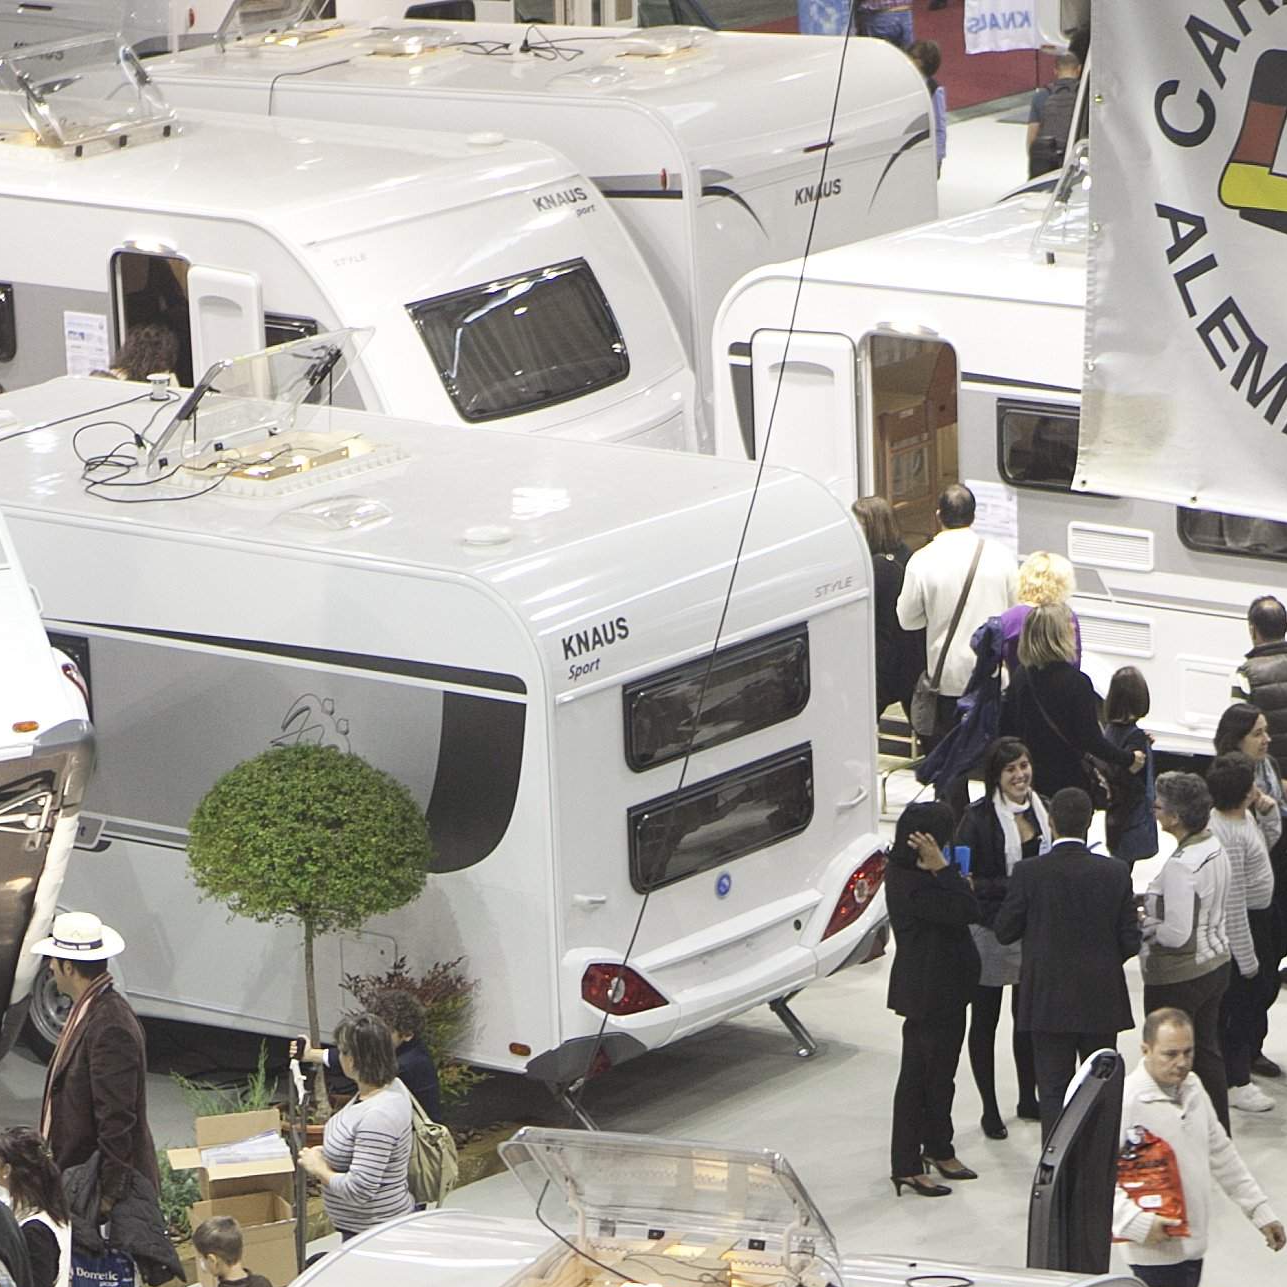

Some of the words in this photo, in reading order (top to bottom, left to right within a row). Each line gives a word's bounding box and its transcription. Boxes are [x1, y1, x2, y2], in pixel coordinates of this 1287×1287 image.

[532, 187, 588, 212] KNAUS
[794, 178, 842, 206] KNAUS
[574, 202, 597, 218] port
[814, 575, 854, 598] STYLE
[561, 615, 630, 661] KNAUS
[567, 657, 602, 682] Sport
[75, 1266, 119, 1281] Dometic
